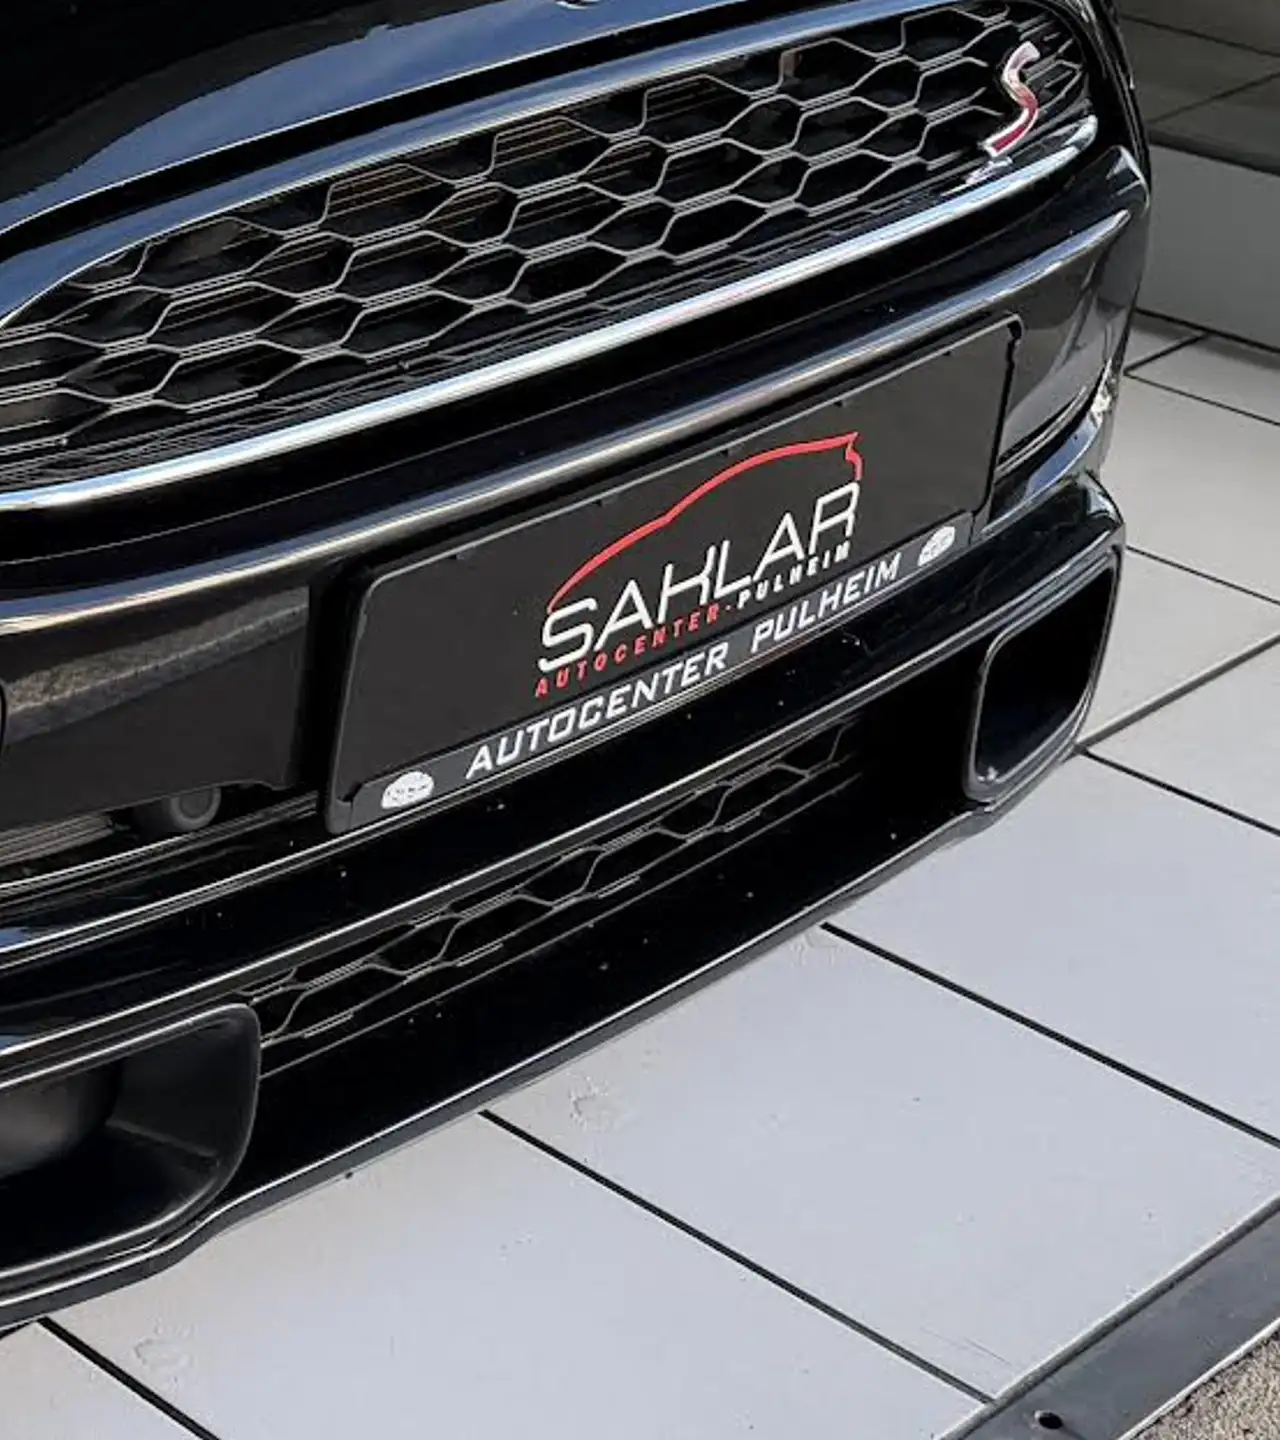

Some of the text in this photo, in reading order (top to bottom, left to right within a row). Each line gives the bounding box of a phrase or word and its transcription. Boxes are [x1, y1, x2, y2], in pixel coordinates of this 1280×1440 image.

[465, 552, 901, 779] AUTOCENTER PULHEIM
[535, 541, 851, 699] AUTOCENTER PULHEIM
[538, 480, 860, 672] SAHLAR
